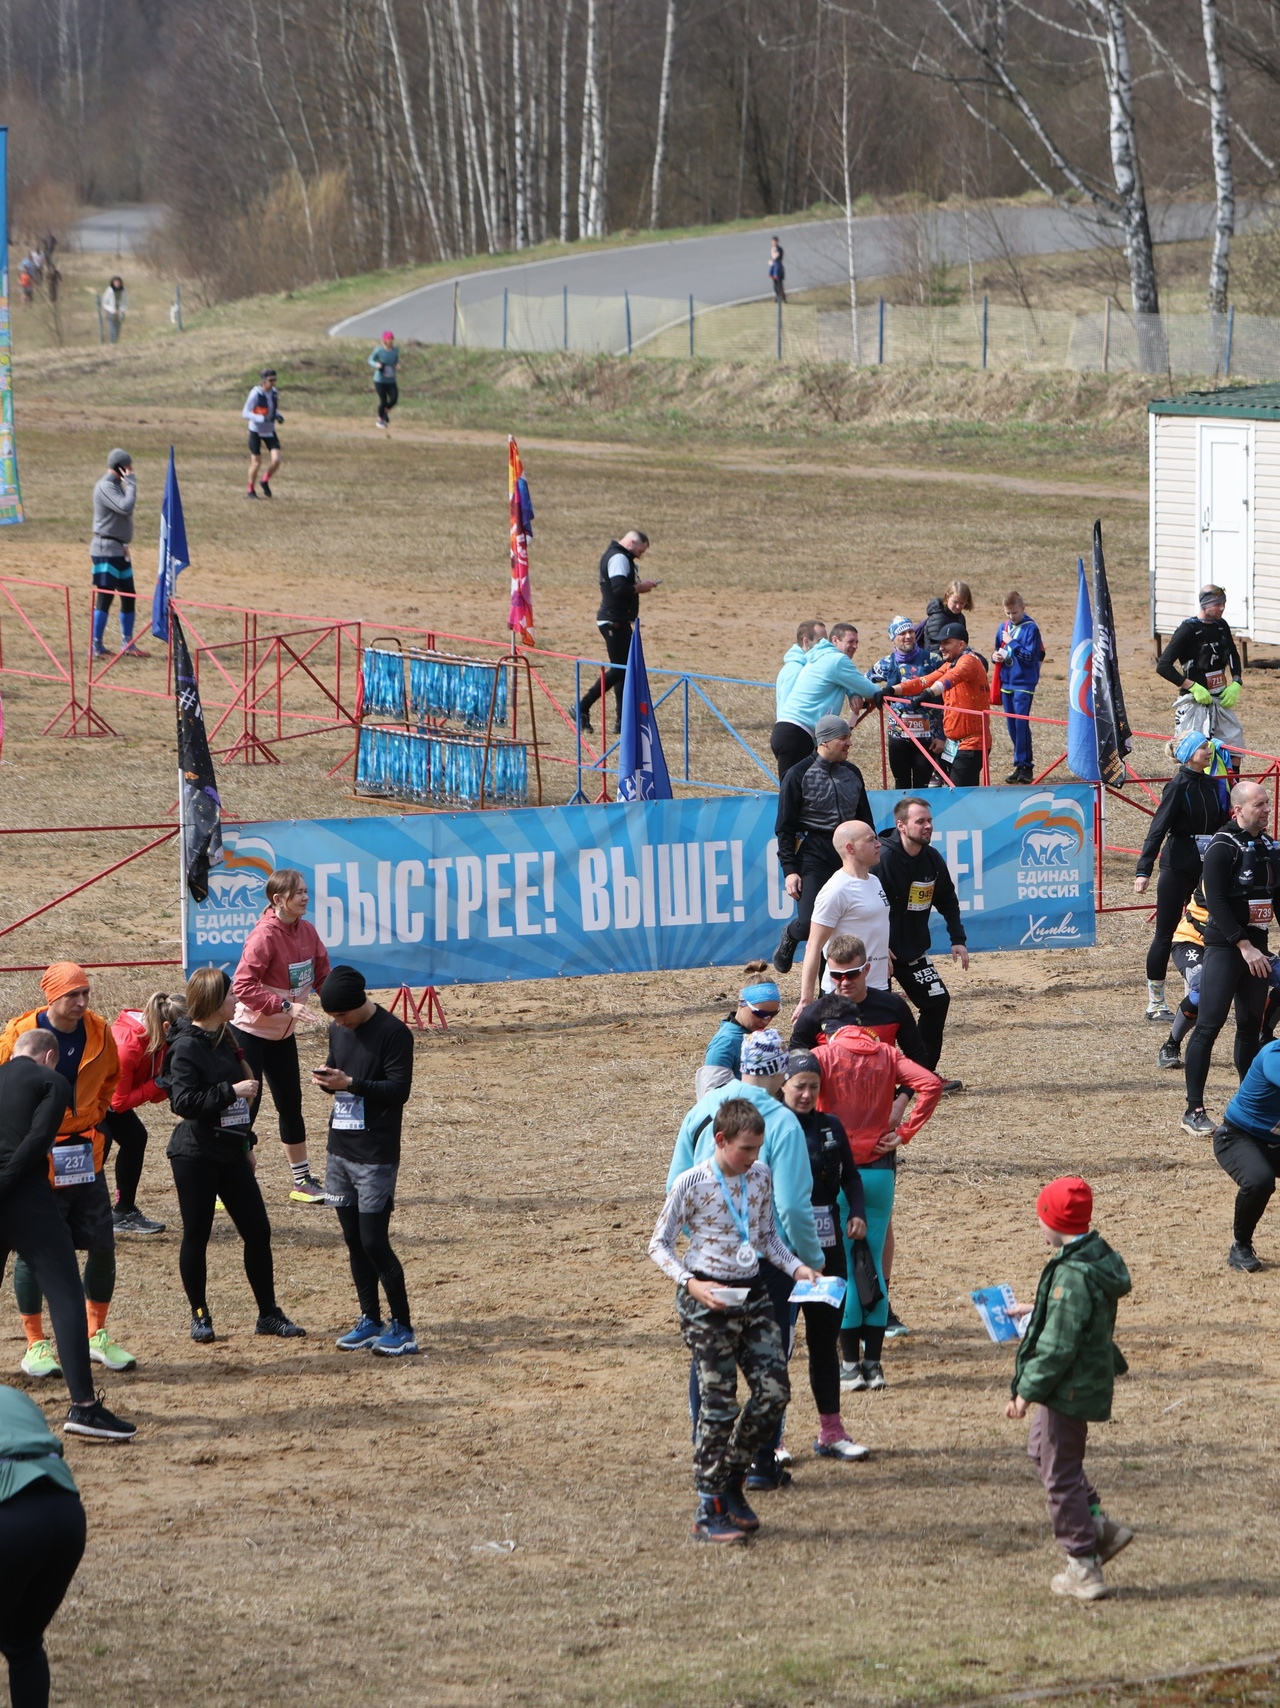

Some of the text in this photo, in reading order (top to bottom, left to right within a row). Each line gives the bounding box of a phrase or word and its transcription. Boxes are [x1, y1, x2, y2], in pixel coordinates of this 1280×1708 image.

[908, 720, 924, 728] 796
[1017, 869, 1079, 884] ЕДИНАЯ
[314, 851, 557, 948] БЫСТРЕЕ!
[578, 840, 745, 931] ВЫШЕ!
[1018, 884, 1080, 899] РОССИЯ
[1258, 909, 1271, 918] 739
[195, 913, 261, 929] ЕДИНА
[1020, 911, 1081, 945] Химки
[197, 929, 250, 945] РОСС
[298, 969, 311, 980] 462
[916, 974, 940, 985] YOR
[335, 1102, 354, 1113] 327
[65, 1156, 86, 1169] 237
[816, 1218, 830, 1230] 05
